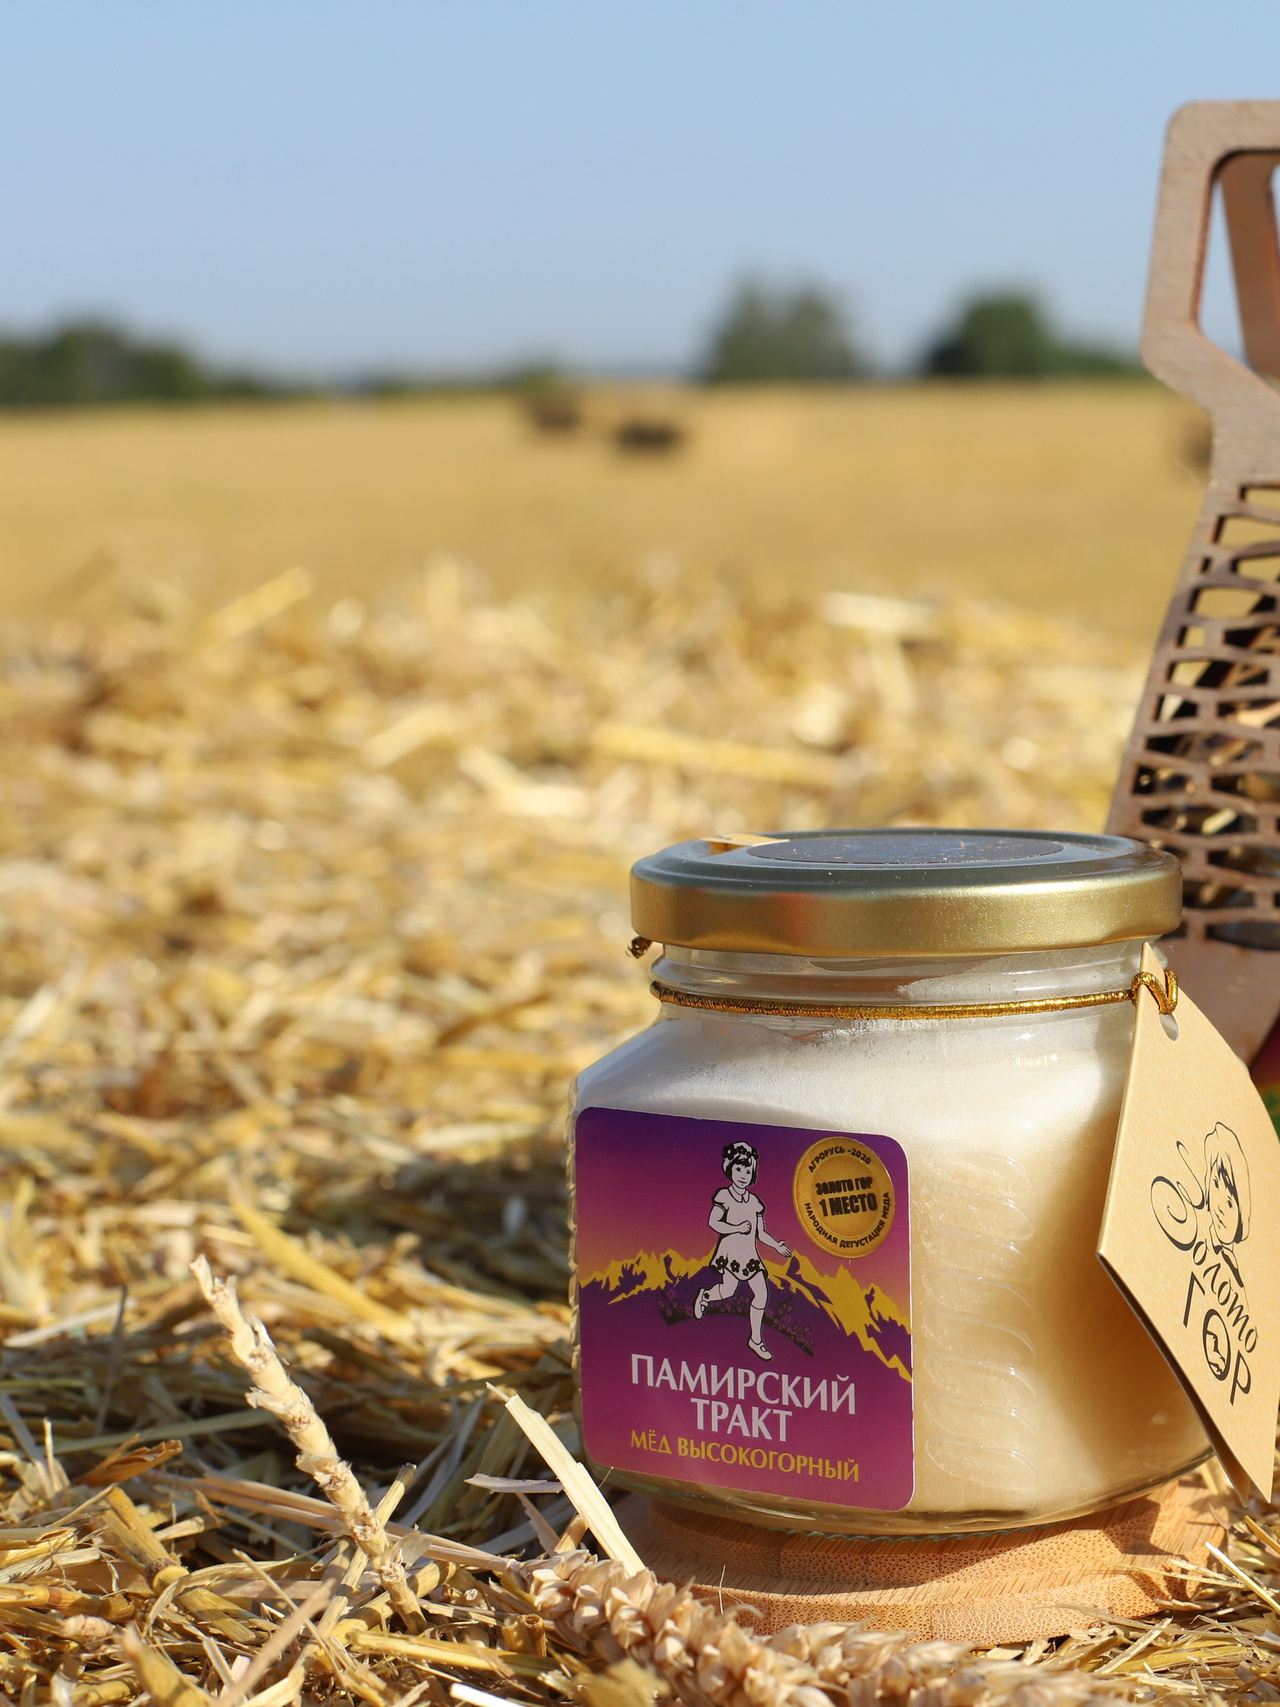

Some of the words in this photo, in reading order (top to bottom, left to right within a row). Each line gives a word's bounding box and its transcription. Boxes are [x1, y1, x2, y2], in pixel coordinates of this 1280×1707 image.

[808, 1146, 845, 1173] АГРОРУСЬ
[819, 1198, 829, 1217] 1
[829, 1193, 878, 1216] МЕСТО
[855, 1176, 873, 1191] ГОР
[805, 1202, 839, 1245] НАРОДНАЯ
[839, 1219, 886, 1248] ДЕГУСТАЦИЯ
[881, 1192, 891, 1219] МЕДА
[631, 1353, 856, 1415] ПАМИРСКИЙ
[690, 1397, 793, 1442] ТРАКТ
[630, 1429, 672, 1455] МЁД
[677, 1437, 860, 1483] ВЫСОКОГОРНЫЙ
